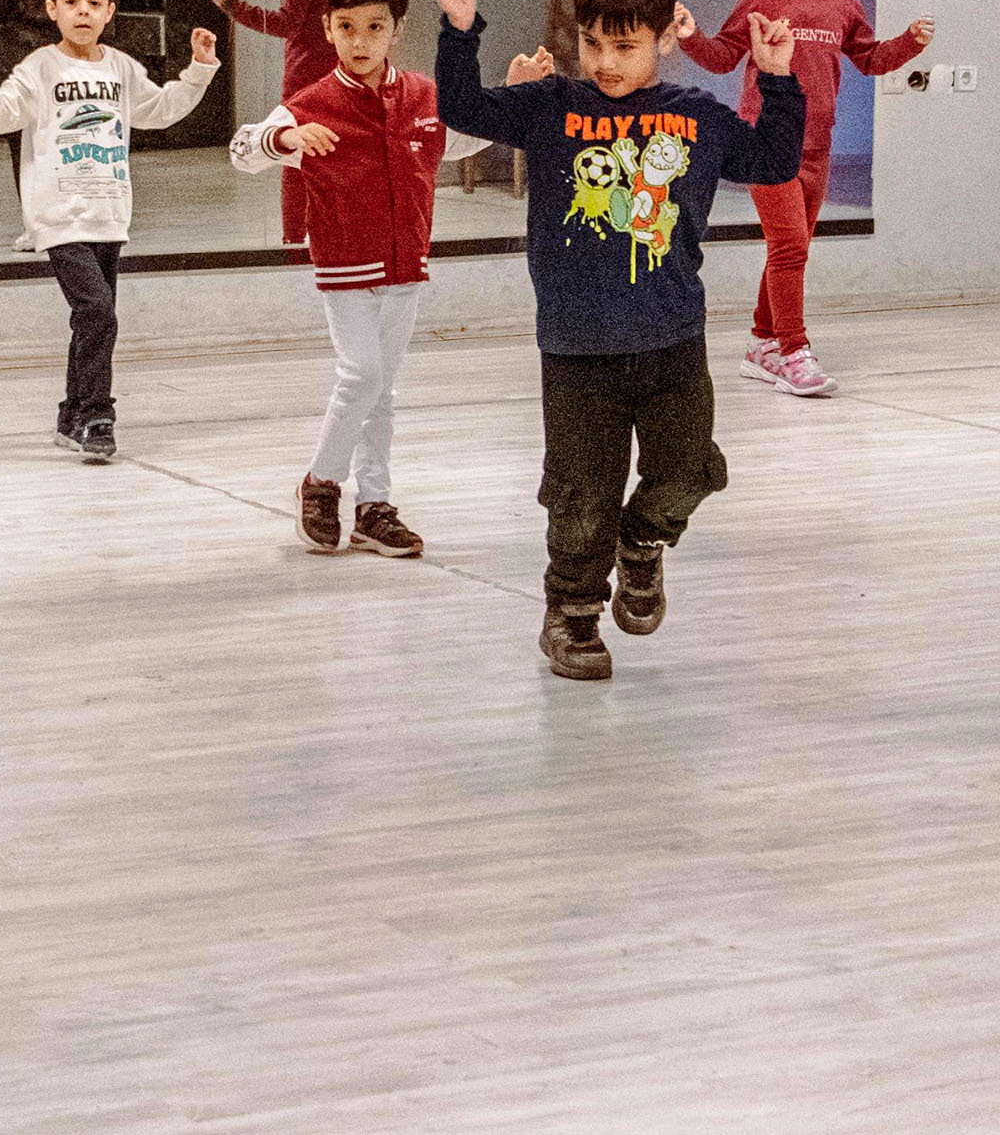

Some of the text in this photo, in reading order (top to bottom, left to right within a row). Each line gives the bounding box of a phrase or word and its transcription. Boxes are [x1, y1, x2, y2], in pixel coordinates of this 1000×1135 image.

[791, 27, 842, 45] GENTIN
[565, 112, 697, 143] PLAY TIME
